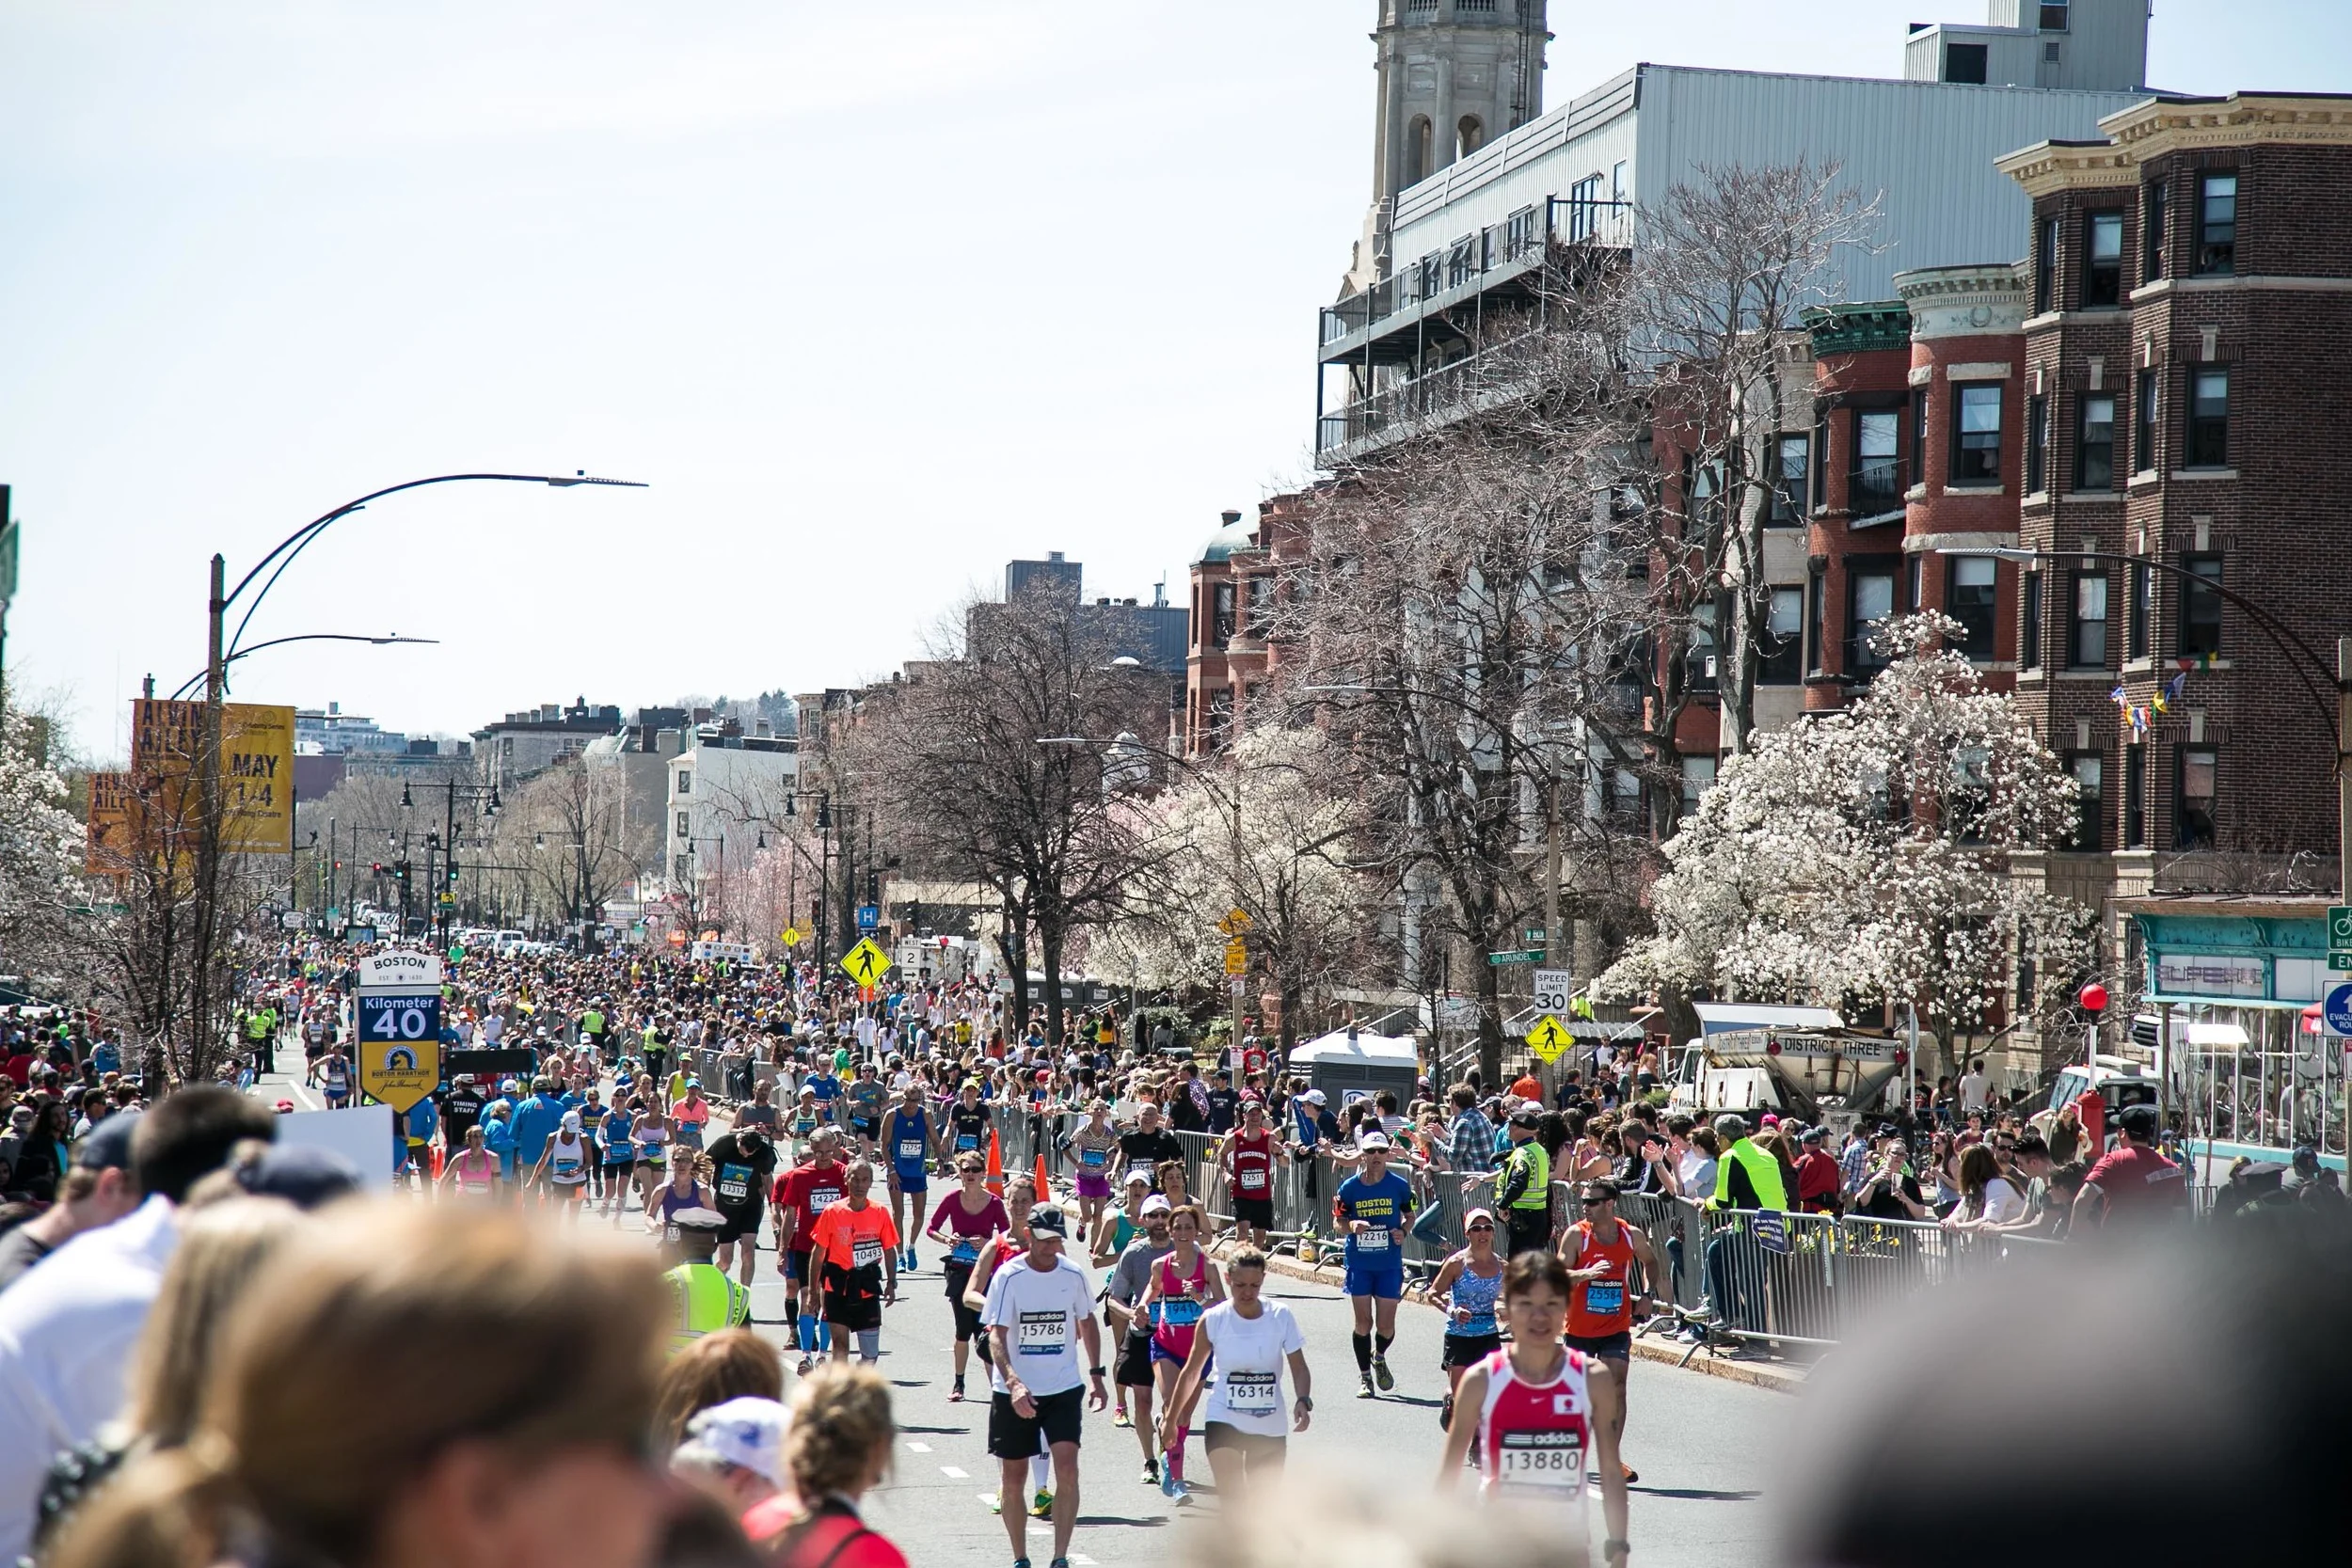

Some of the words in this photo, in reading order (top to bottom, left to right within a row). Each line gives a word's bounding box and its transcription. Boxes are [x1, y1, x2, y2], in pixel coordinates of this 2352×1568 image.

[232, 753, 279, 779] MAY
[236, 782, 273, 807] 1-4
[864, 911, 873, 922] H
[373, 958, 426, 970] BOSTON
[907, 952, 914, 964] 2
[1502, 953, 1532, 963] ARUNDEL
[366, 997, 434, 1009] Kilometer
[1536, 992, 1565, 1009] 30
[373, 1008, 426, 1038] 40
[1785, 1037, 1836, 1053] DISTRICT
[1843, 1041, 1881, 1055] THREE
[453, 1101, 477, 1109] TIMING
[1238, 1150, 1266, 1160] WISCONSIN
[722, 1184, 745, 1196] 13312
[812, 1195, 839, 1203] 14224
[1356, 1197, 1392, 1209] BOSTON
[1357, 1207, 1392, 1217] STRONG
[1359, 1232, 1388, 1241] 12216
[855, 1247, 882, 1260] 10493
[1590, 1289, 1622, 1300] 25584
[1039, 1312, 1065, 1321] adidas
[1022, 1323, 1064, 1336] 15786
[1230, 1386, 1274, 1398] 16314
[1534, 1432, 1579, 1446] adidas
[1505, 1451, 1579, 1470] 13880
